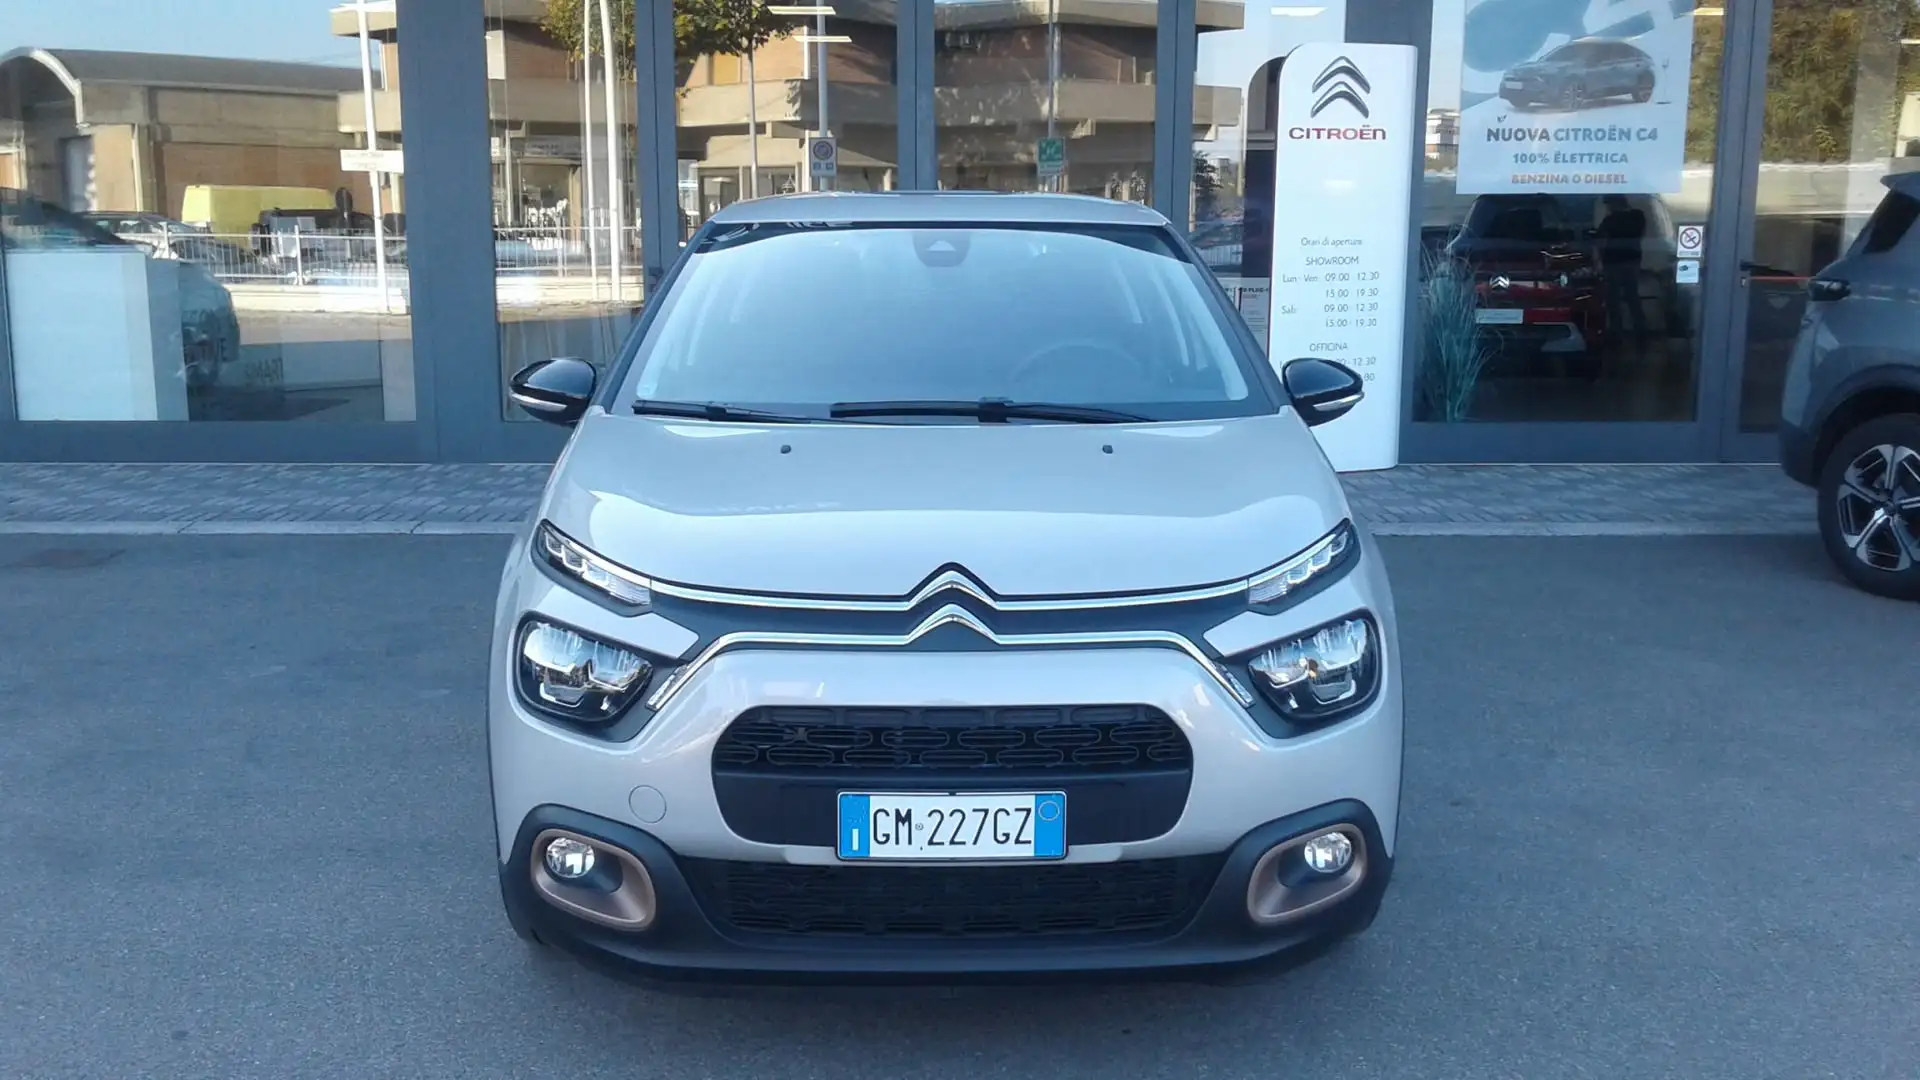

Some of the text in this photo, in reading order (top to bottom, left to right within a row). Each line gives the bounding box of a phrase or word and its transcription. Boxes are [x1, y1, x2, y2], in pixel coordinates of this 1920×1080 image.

[1486, 125, 1659, 143] NUOVA CITROËN C4
[1512, 153, 1550, 164] 100%
[1511, 173, 1628, 185] BENZINA O DIESEL
[1301, 236, 1362, 249] Orari di apertura
[1305, 255, 1359, 267] SHOWROOM
[1282, 273, 1298, 283] Lun
[1324, 272, 1350, 282] 09.00
[1325, 288, 1350, 298] 15.00
[1324, 303, 1349, 313] 09.00
[1325, 317, 1348, 328] 15.00
[1355, 317, 1377, 328] 19.30
[1309, 342, 1349, 352] OFFICINA
[872, 807, 913, 846] GM
[926, 807, 1033, 846] 227GZ
